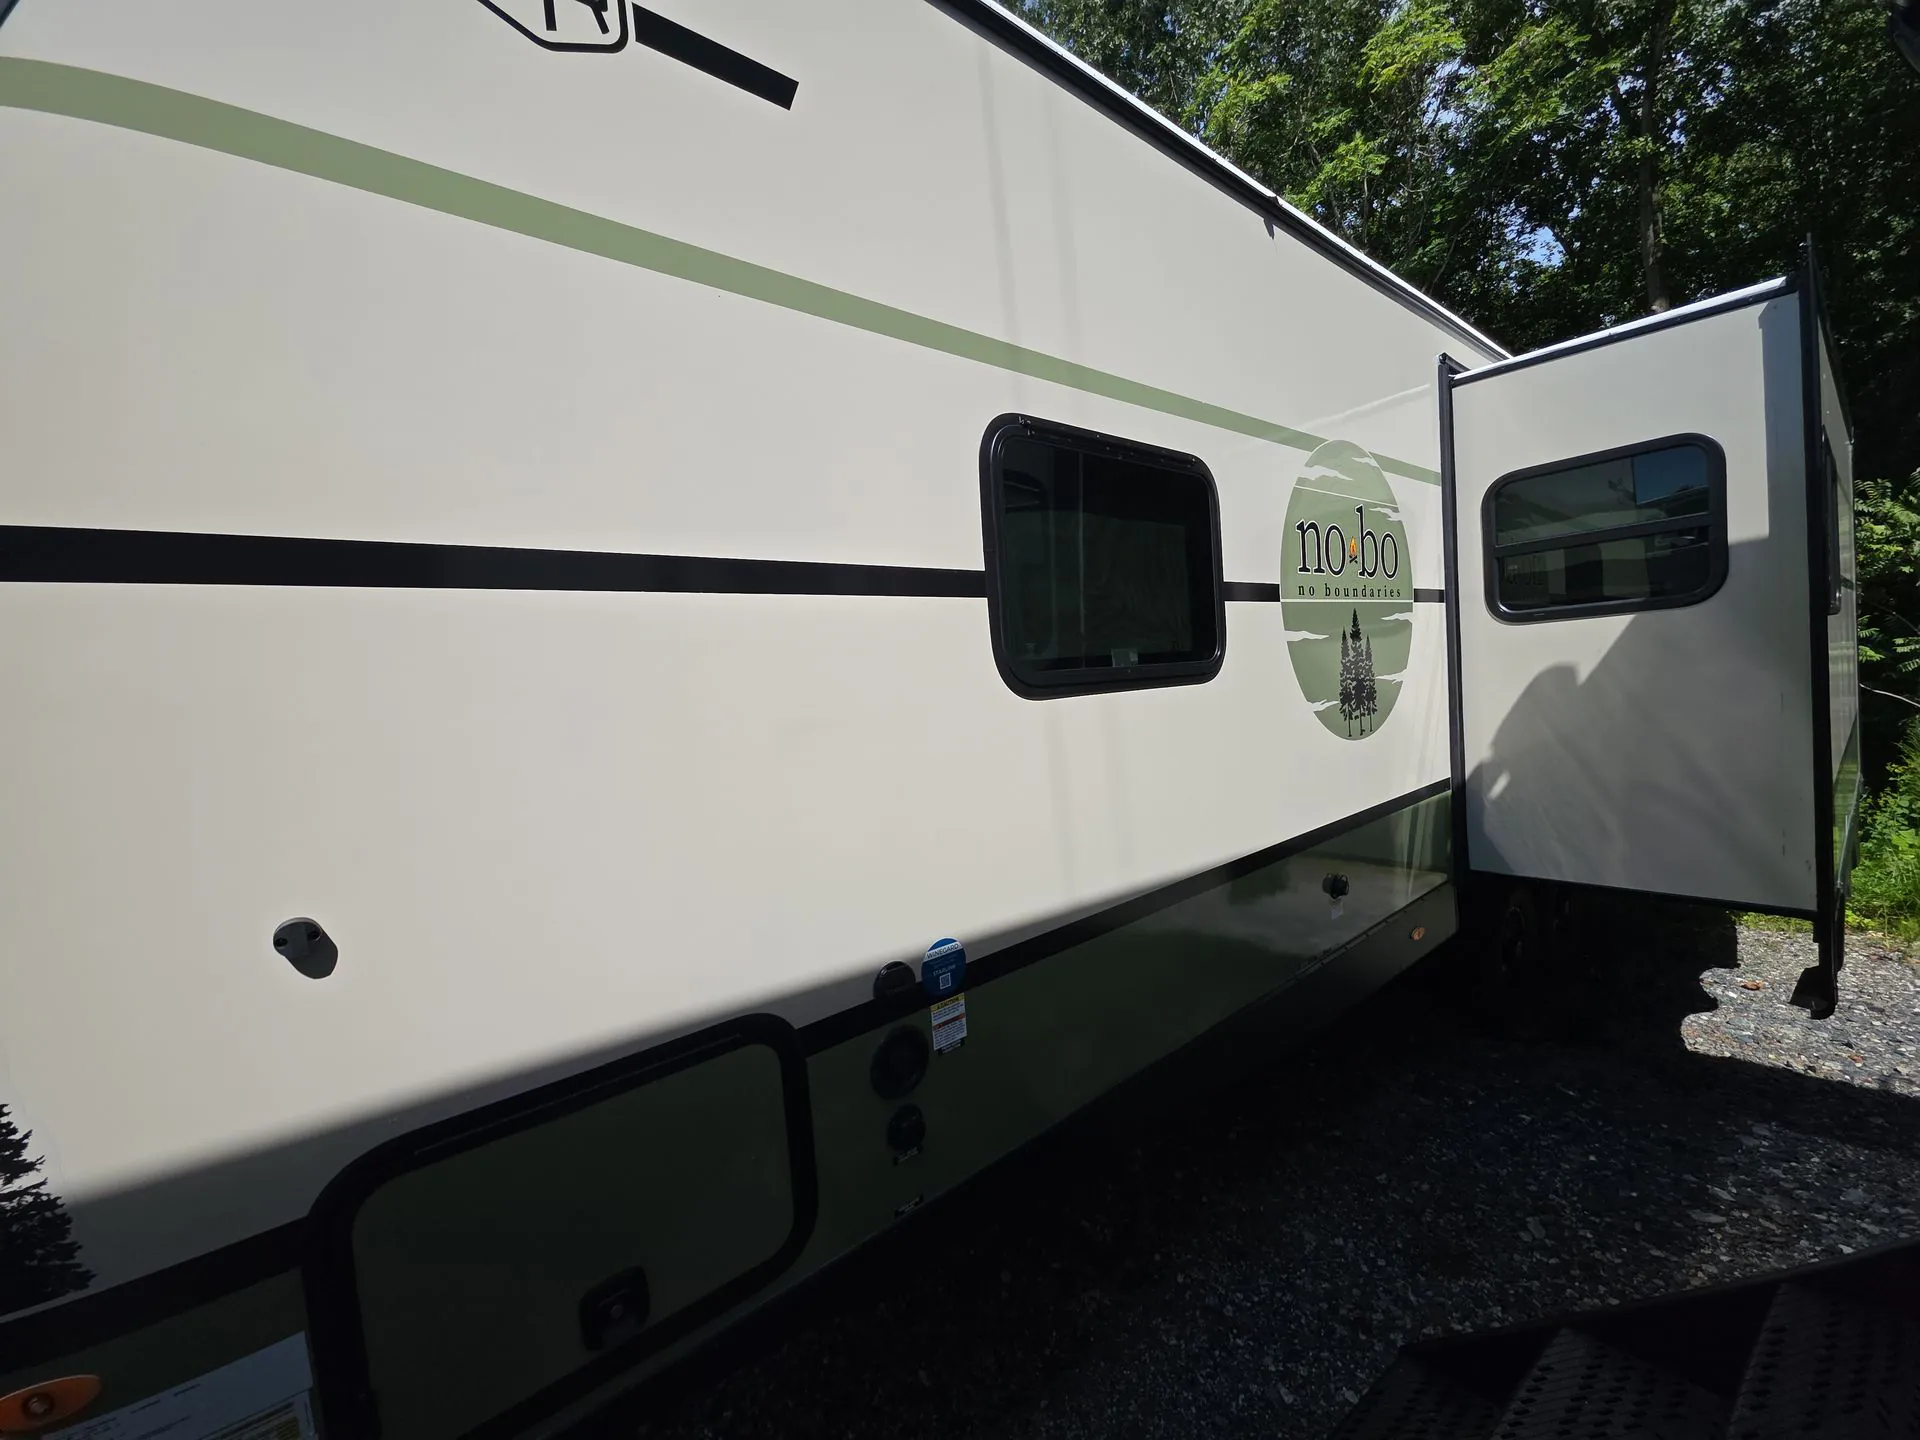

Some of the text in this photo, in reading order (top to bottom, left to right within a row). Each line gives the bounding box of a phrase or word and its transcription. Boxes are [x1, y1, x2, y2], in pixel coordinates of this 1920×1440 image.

[1298, 582, 1402, 598] no boundaries
[926, 943, 960, 959] WINEGARD
